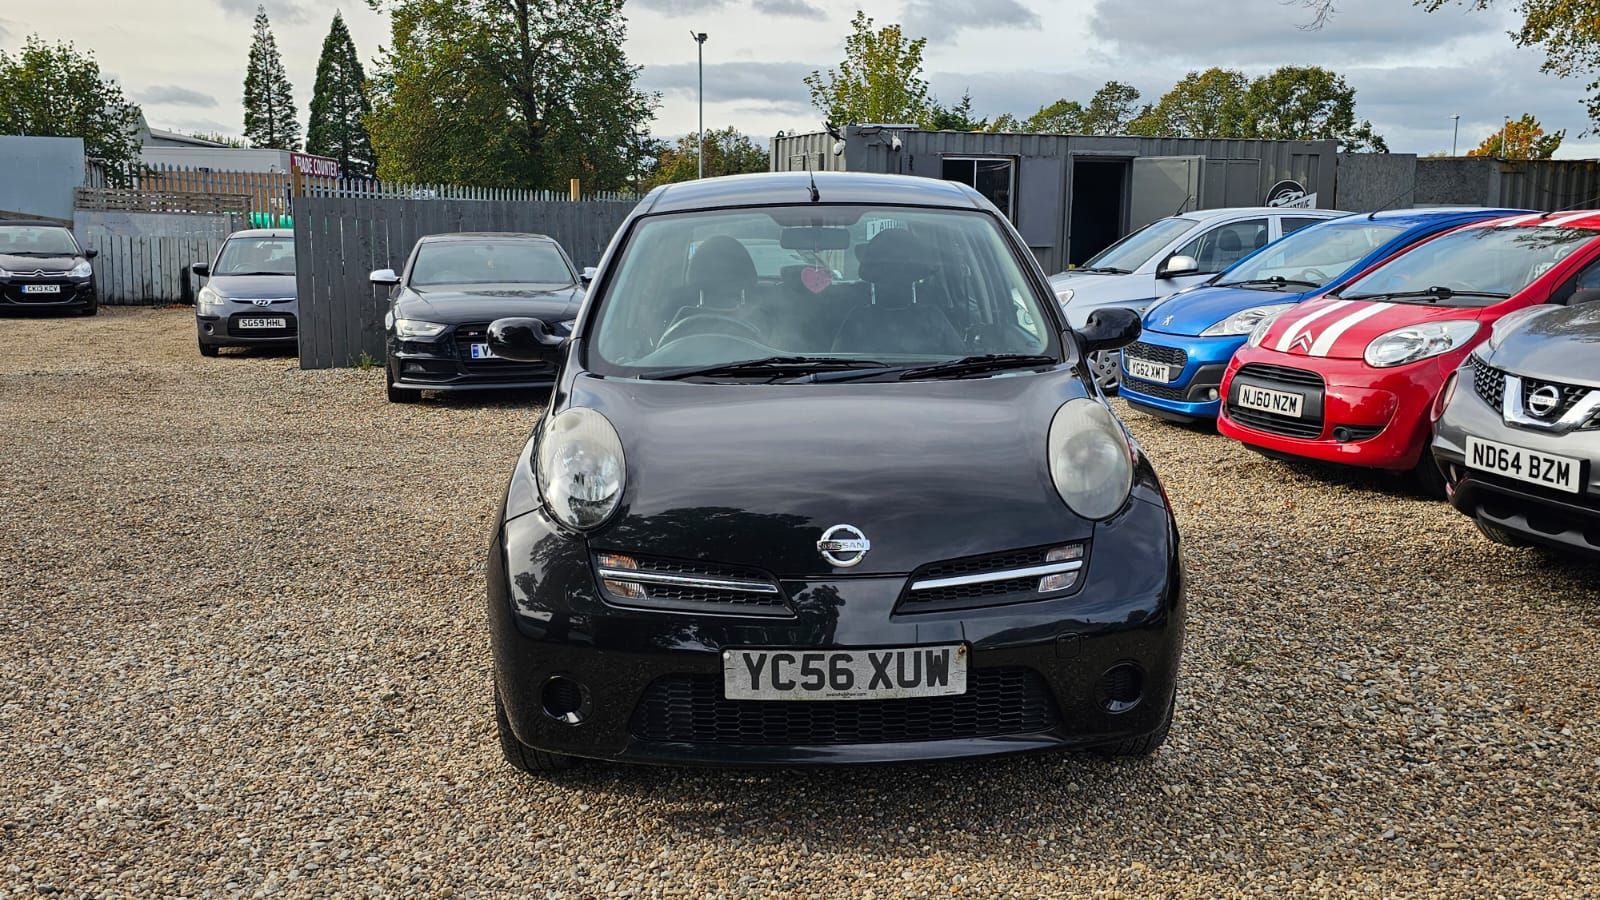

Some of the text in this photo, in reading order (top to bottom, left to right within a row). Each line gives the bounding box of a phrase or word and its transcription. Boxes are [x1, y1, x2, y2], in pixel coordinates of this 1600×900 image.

[294, 156, 338, 177] TRADE COUNTER
[242, 319, 284, 327] SG59 HHL
[1132, 361, 1166, 380] YG62 XMT
[1242, 389, 1298, 413] NJ60 NZM
[1473, 442, 1570, 487] ND64 BZM
[742, 648, 950, 691] YC56 XUW
